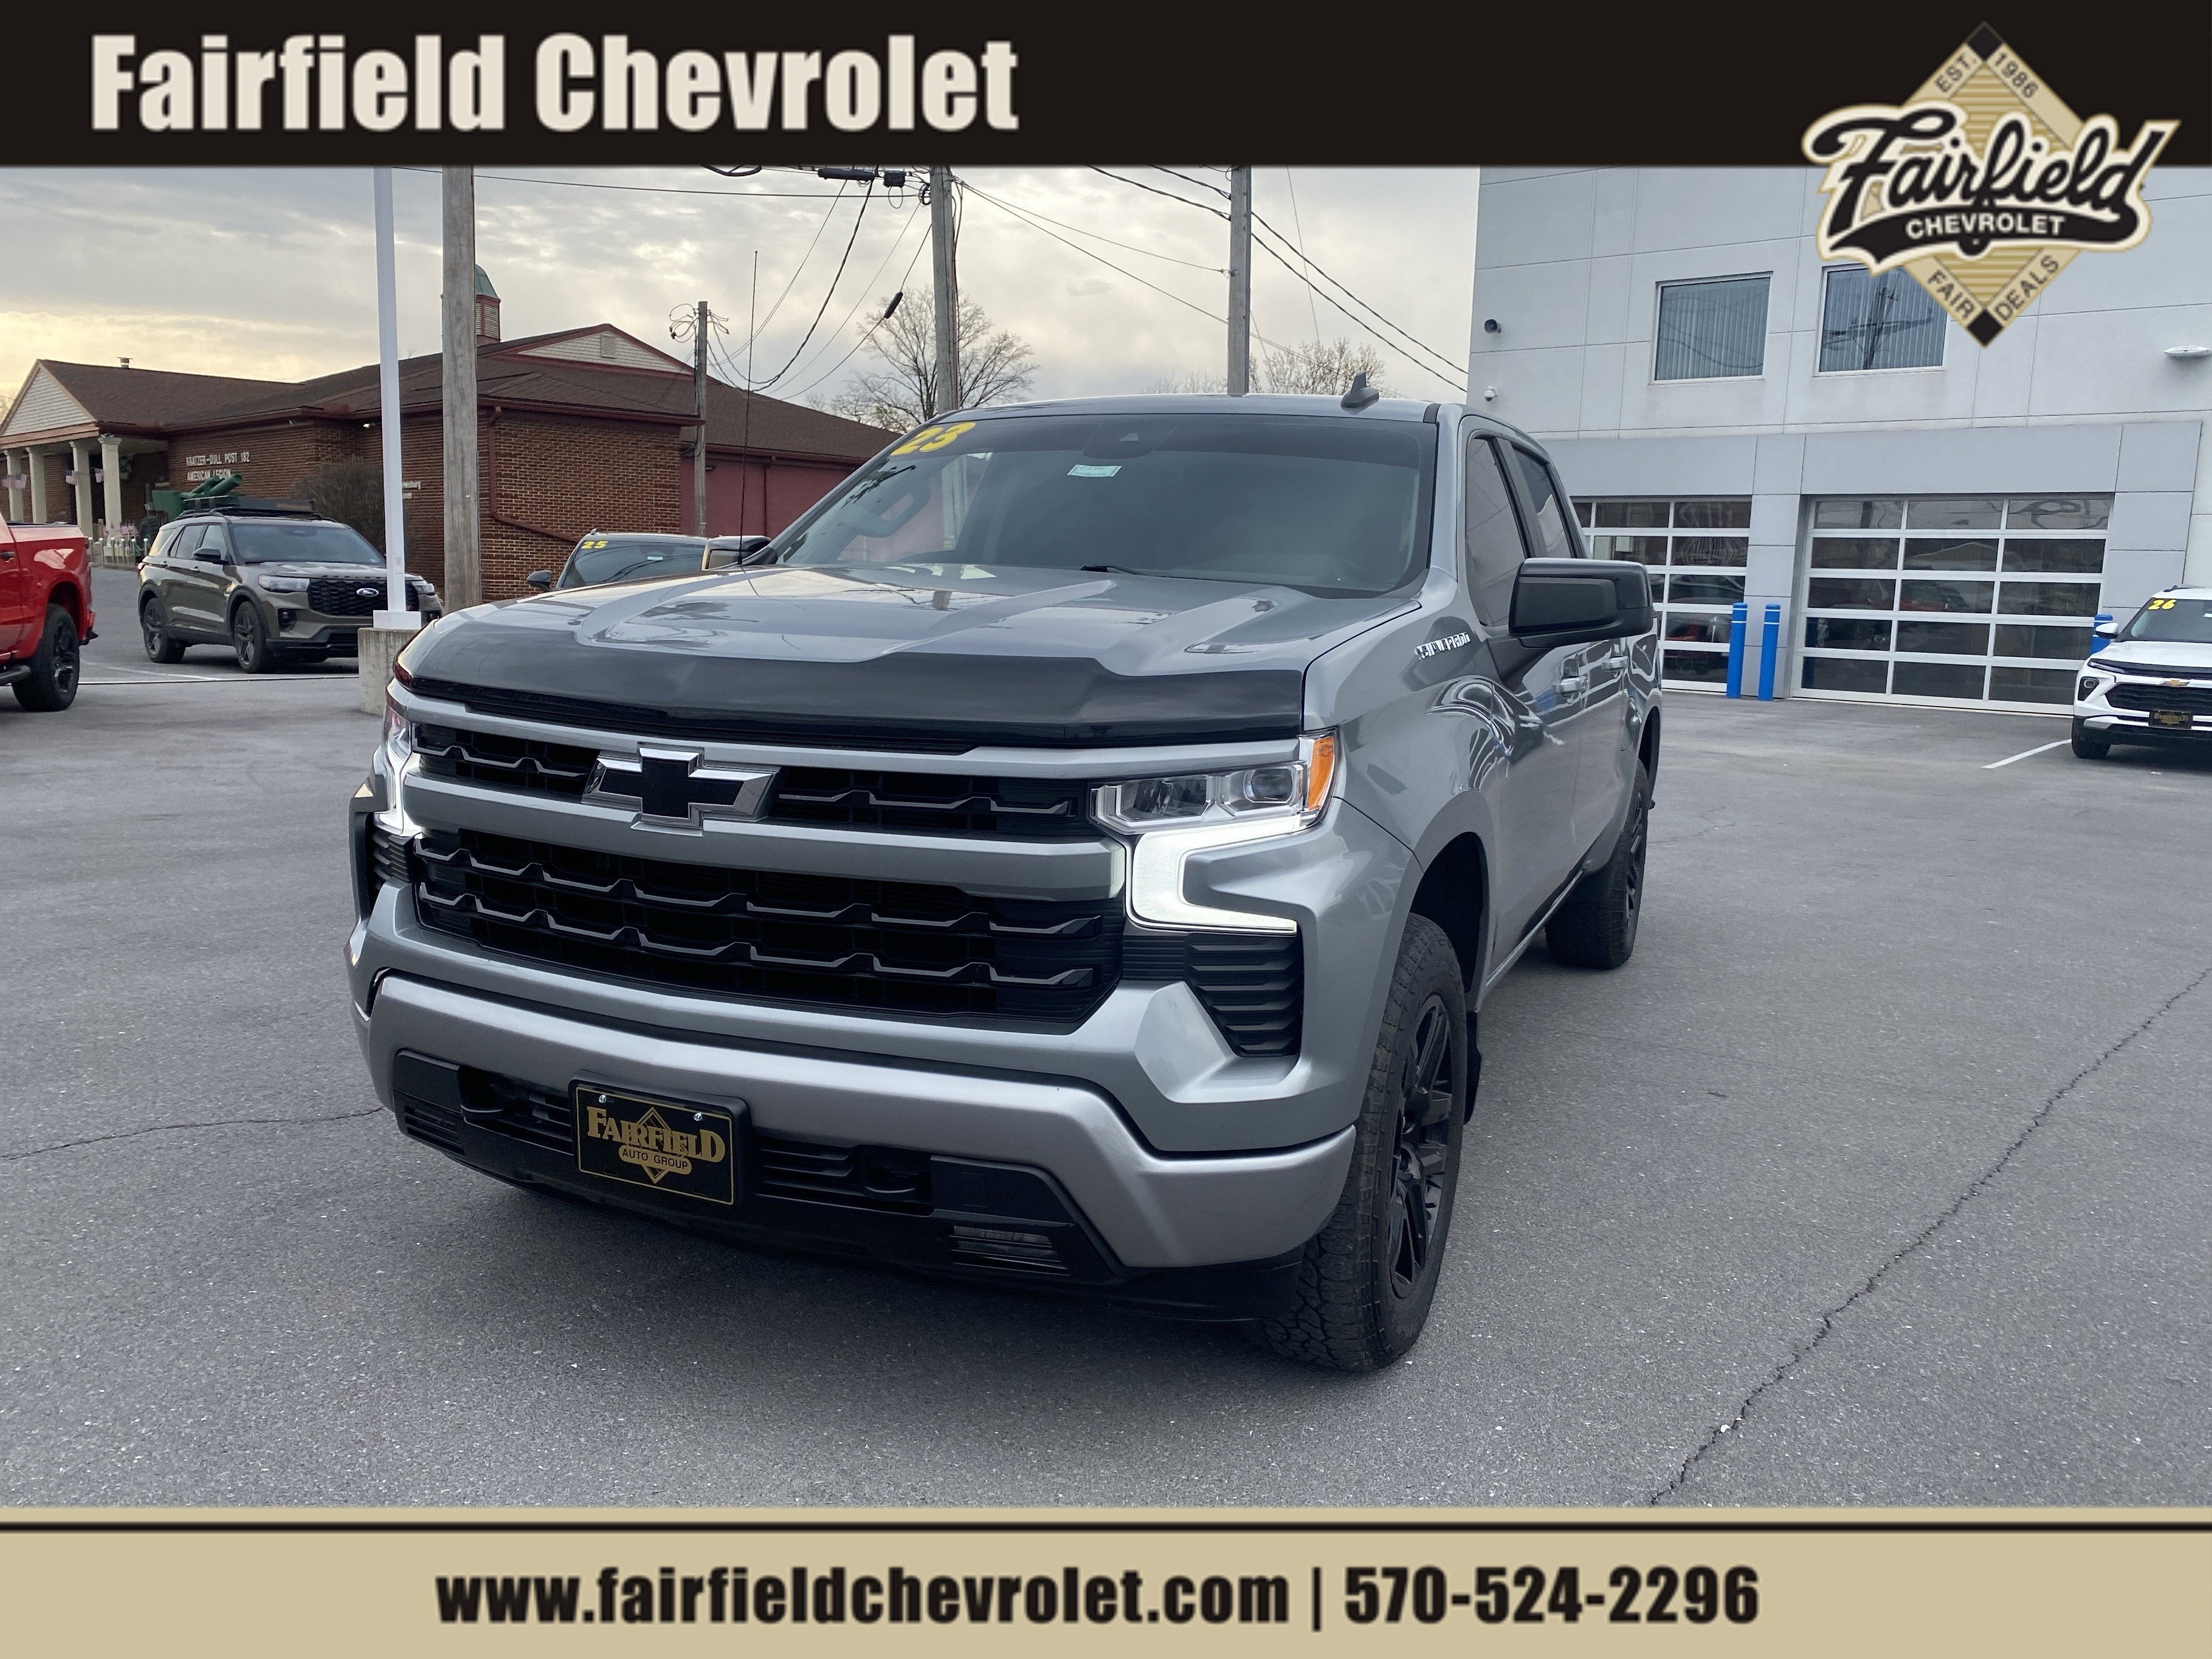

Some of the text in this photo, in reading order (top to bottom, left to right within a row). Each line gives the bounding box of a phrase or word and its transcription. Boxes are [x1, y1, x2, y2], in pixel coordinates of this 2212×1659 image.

[890, 421, 977, 456] 23
[224, 452, 238, 464] POST
[241, 451, 250, 462] 182
[580, 540, 608, 549] 25
[2148, 599, 2177, 611] 26
[586, 1106, 726, 1163] FAIRFIELD
[622, 1148, 688, 1170] AUTO GROUP
